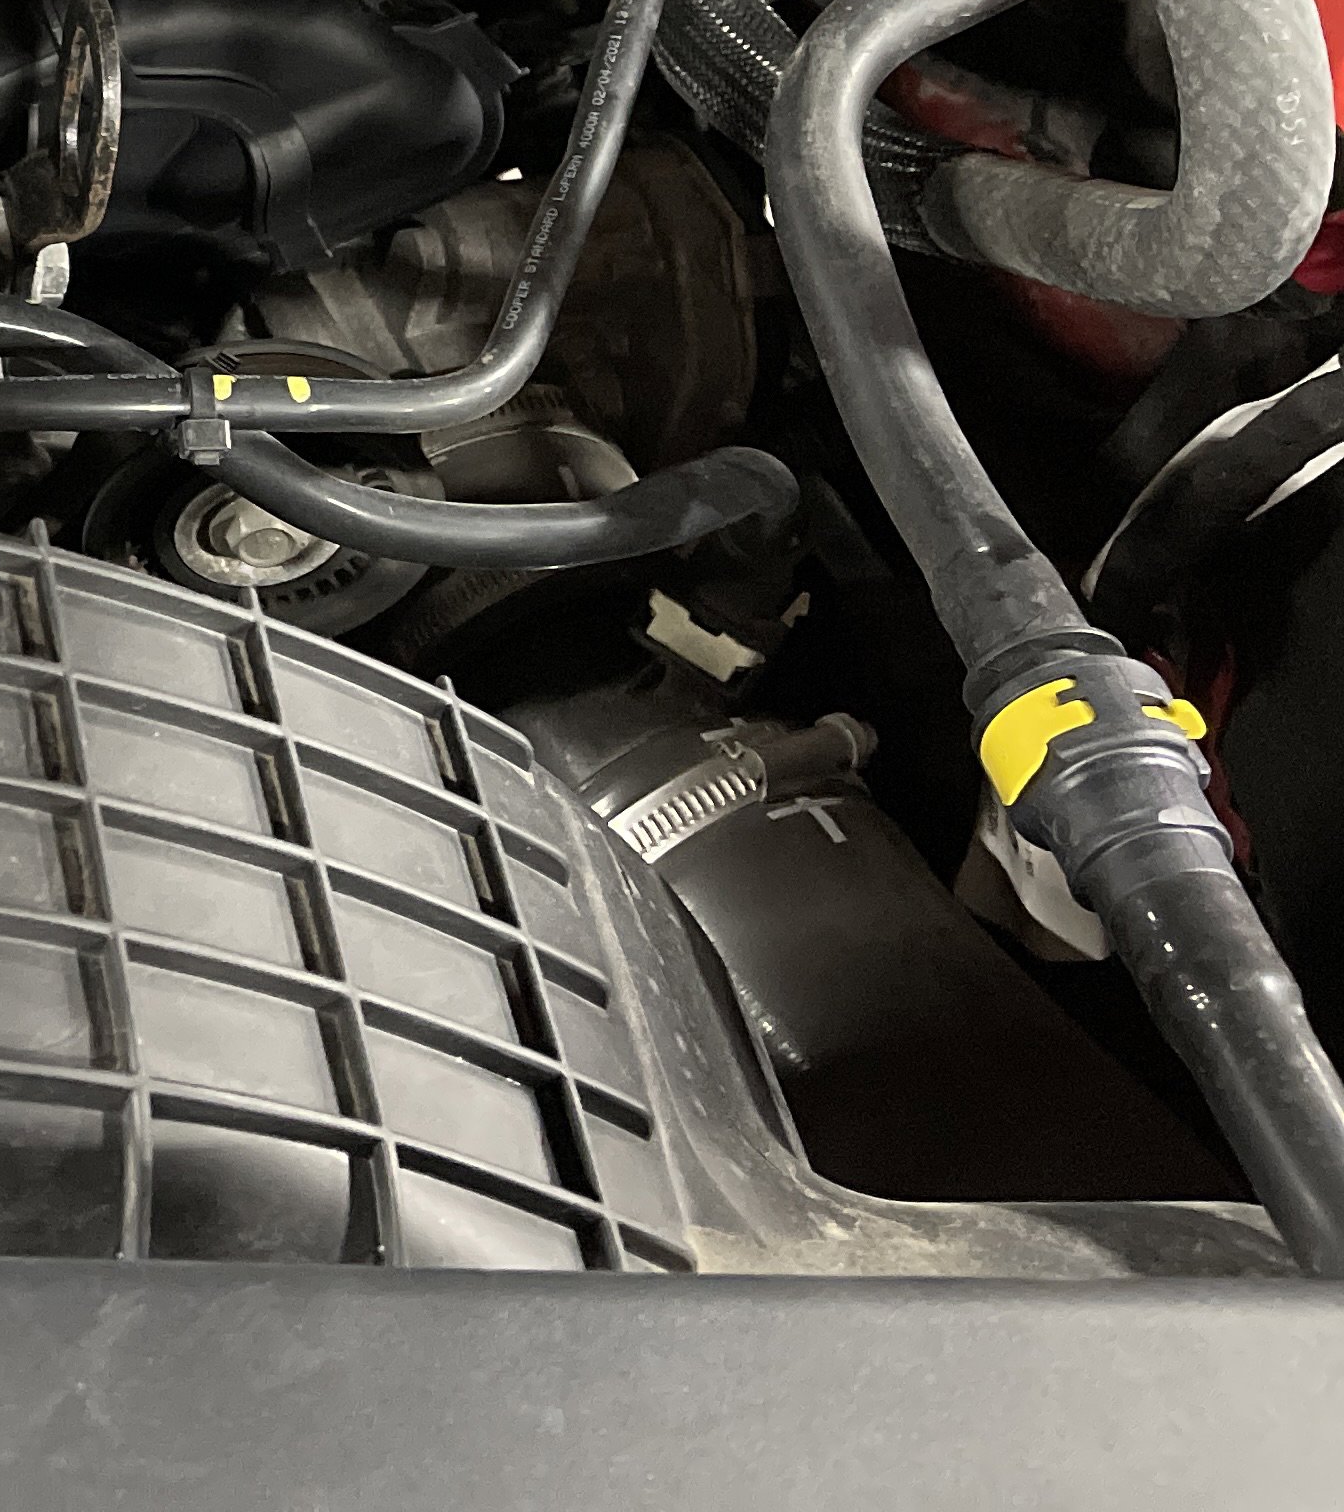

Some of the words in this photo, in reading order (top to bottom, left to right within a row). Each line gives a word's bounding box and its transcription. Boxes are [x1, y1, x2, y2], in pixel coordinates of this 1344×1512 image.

[502, 280, 531, 329] COOPER
[525, 207, 559, 273] STANDARD
[592, 35, 622, 106] 02/04/2021
